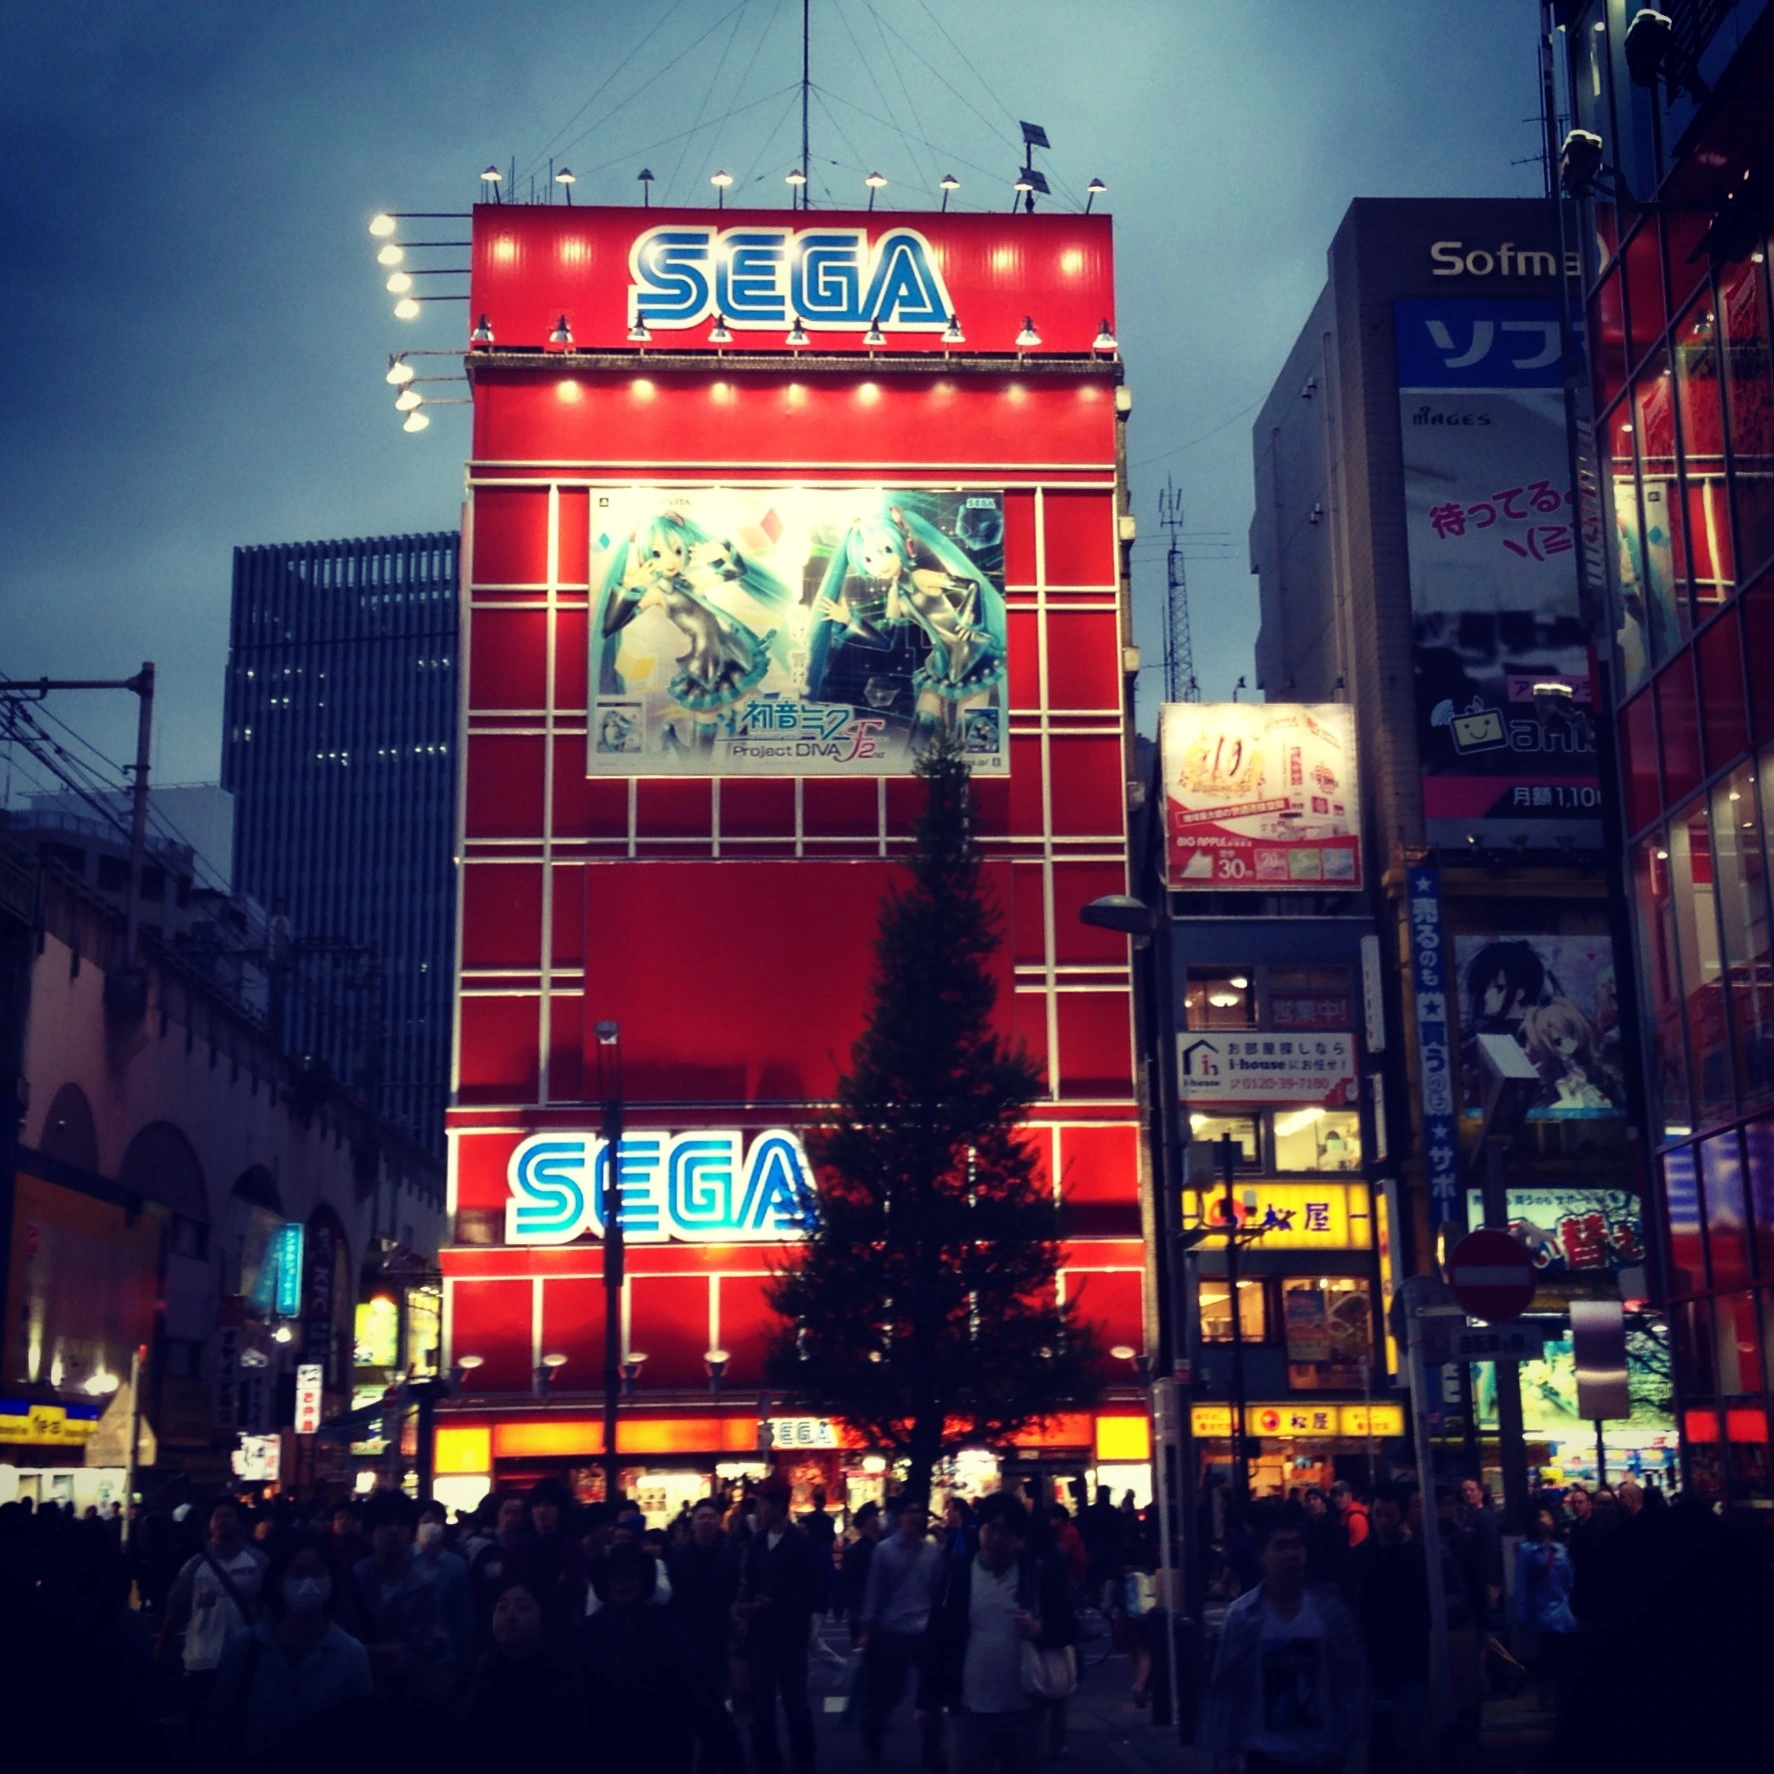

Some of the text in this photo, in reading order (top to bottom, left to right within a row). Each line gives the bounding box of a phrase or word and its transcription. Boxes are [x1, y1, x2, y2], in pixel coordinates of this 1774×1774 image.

[628, 226, 959, 331] SEGA
[966, 497, 996, 509] SEGA
[1429, 480, 1573, 539] 待ってる
[741, 700, 850, 740] 初音ミク
[733, 744, 793, 758] Project
[796, 743, 841, 757] DIVA
[1228, 1042, 1345, 1055] お部屋探しなら
[505, 1129, 818, 1244] SEGA
[766, 1421, 832, 1446] EGA
[1291, 1412, 1328, 1430] 松屋
